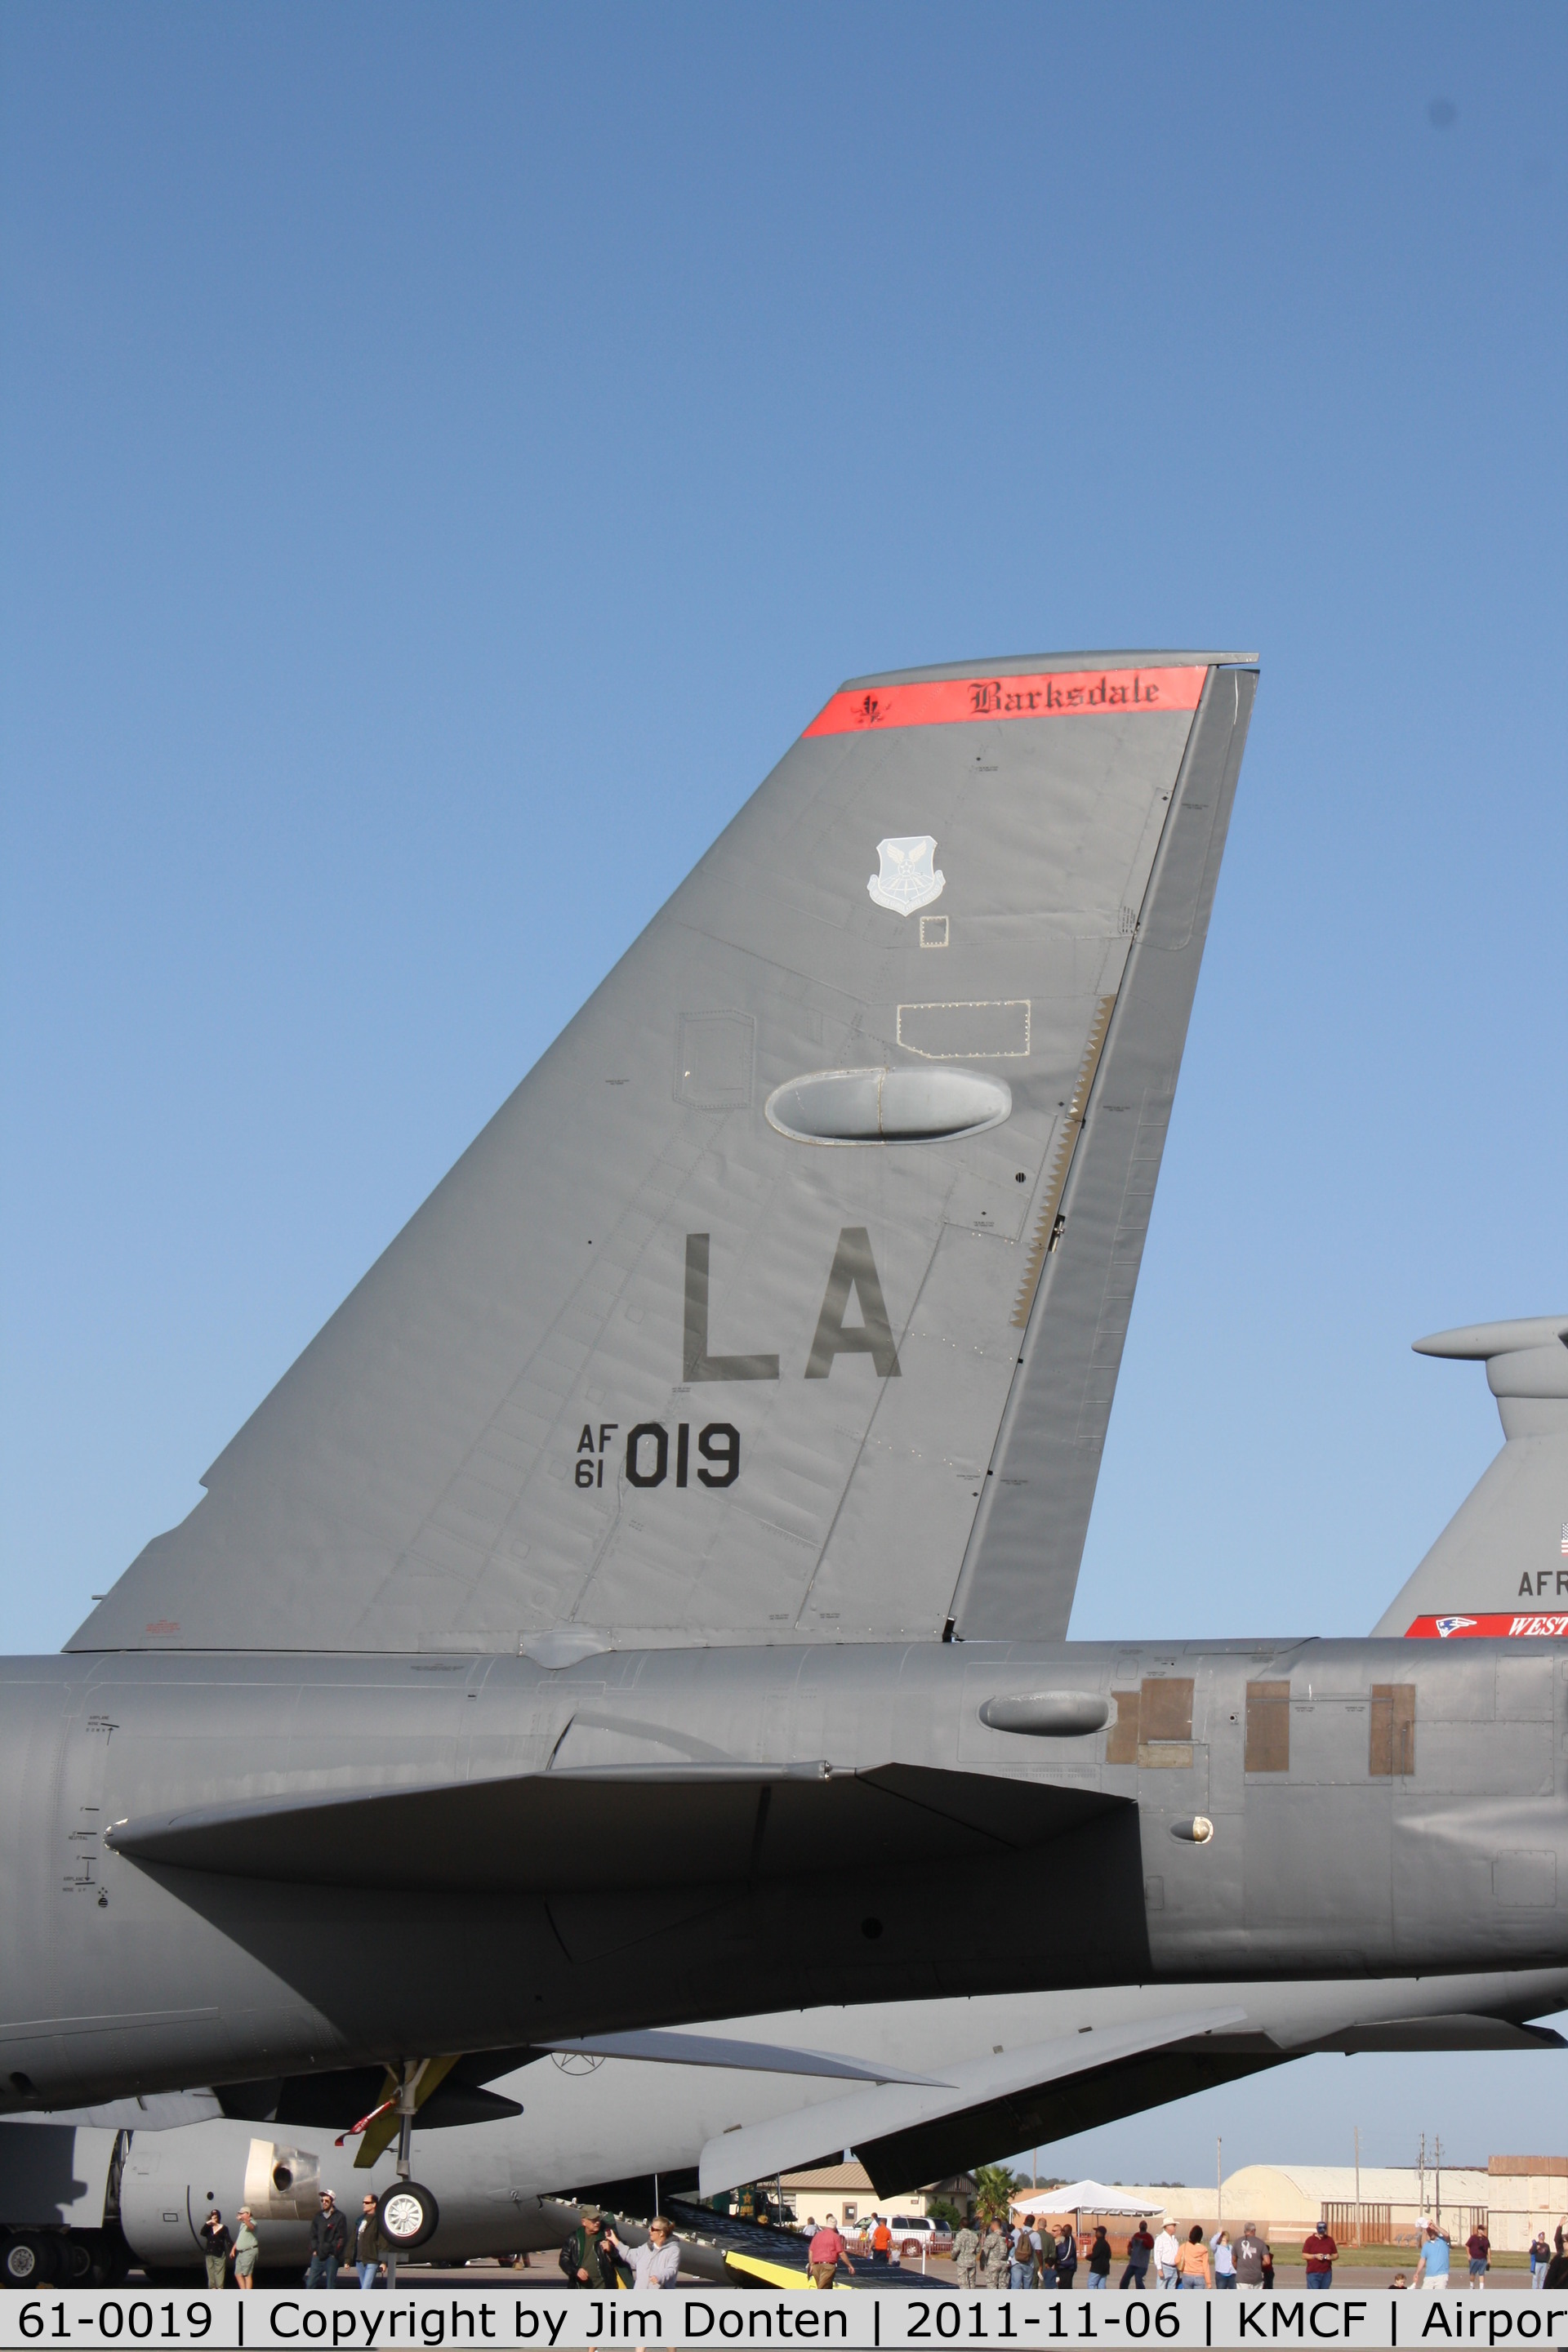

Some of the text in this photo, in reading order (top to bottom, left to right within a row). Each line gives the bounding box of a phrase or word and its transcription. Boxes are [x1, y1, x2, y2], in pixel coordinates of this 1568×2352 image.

[968, 675, 1160, 714] Barksdale
[683, 1227, 902, 1383] LA
[577, 1423, 618, 1453] AF
[626, 1423, 740, 1488] 019
[575, 1459, 604, 1488] 61
[1518, 1570, 1568, 1596] AFR
[1508, 1616, 1568, 1636] WEST
